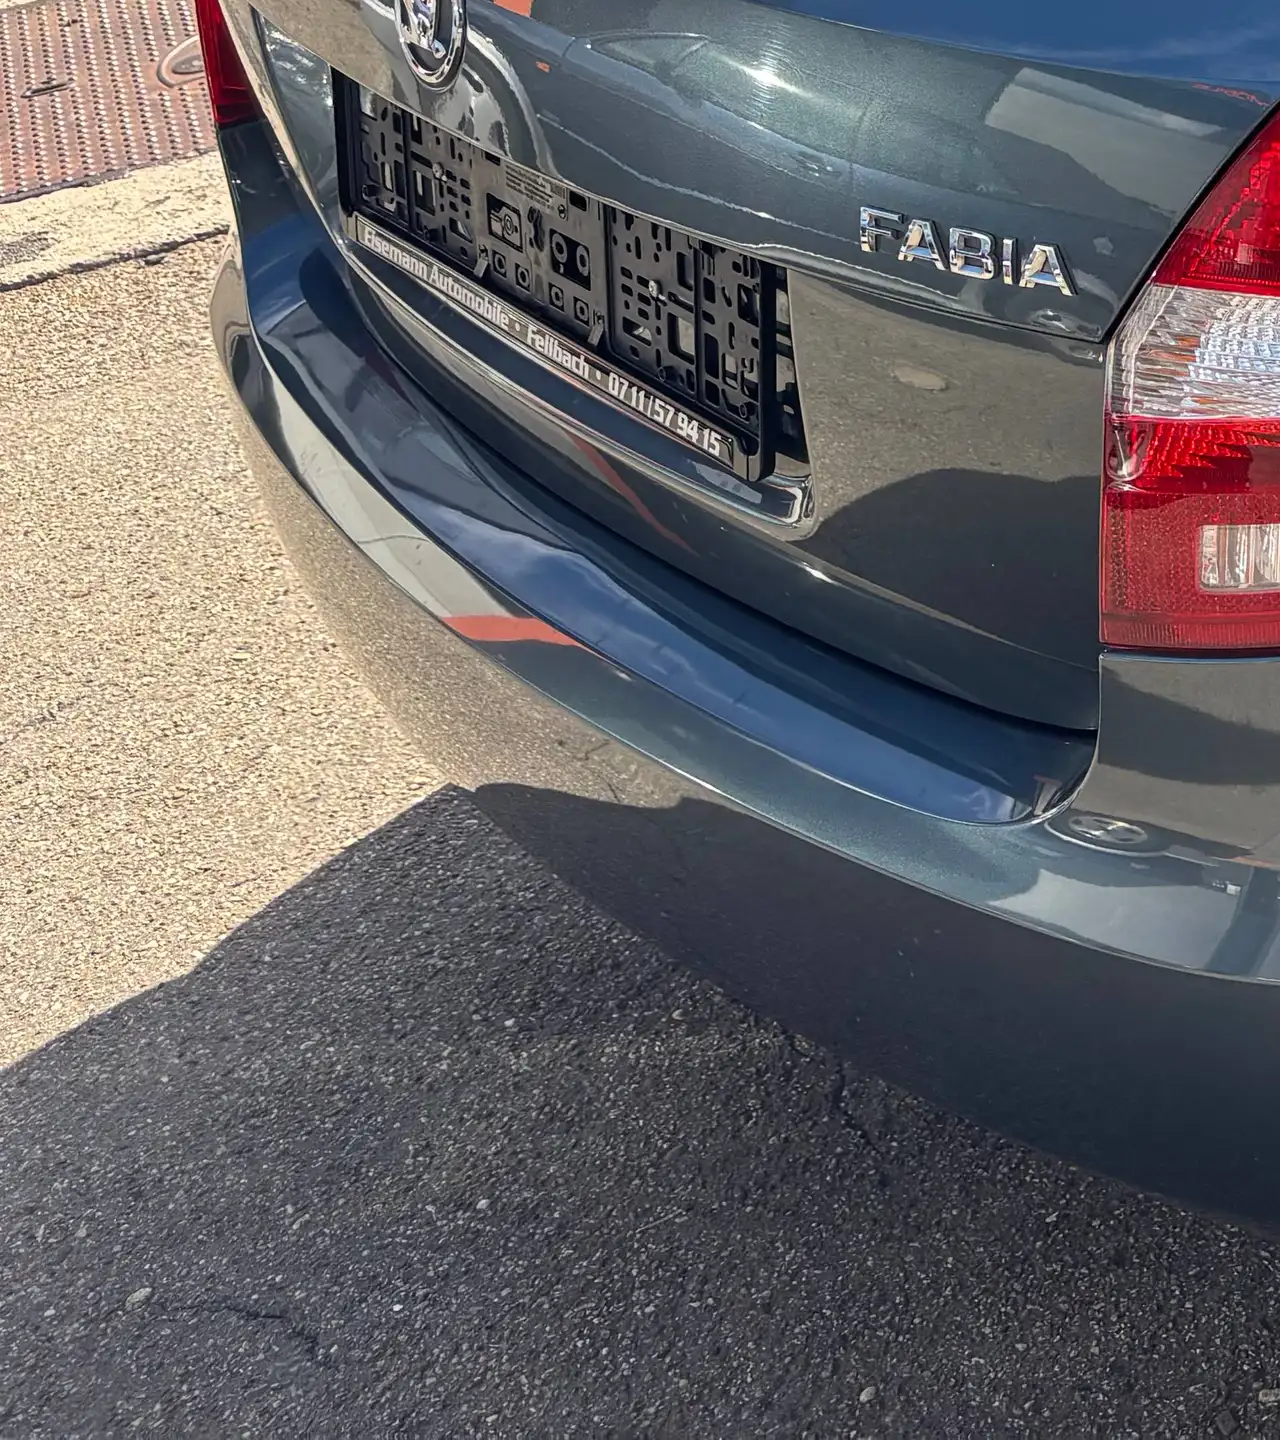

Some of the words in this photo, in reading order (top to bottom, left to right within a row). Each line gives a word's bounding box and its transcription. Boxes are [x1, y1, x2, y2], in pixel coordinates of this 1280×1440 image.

[860, 205, 1078, 297] FABIA
[363, 226, 428, 282] Eisemann
[428, 265, 510, 330] Automobile
[526, 326, 590, 380] Fellbach
[676, 413, 699, 444] 94
[699, 428, 722, 457] 15
